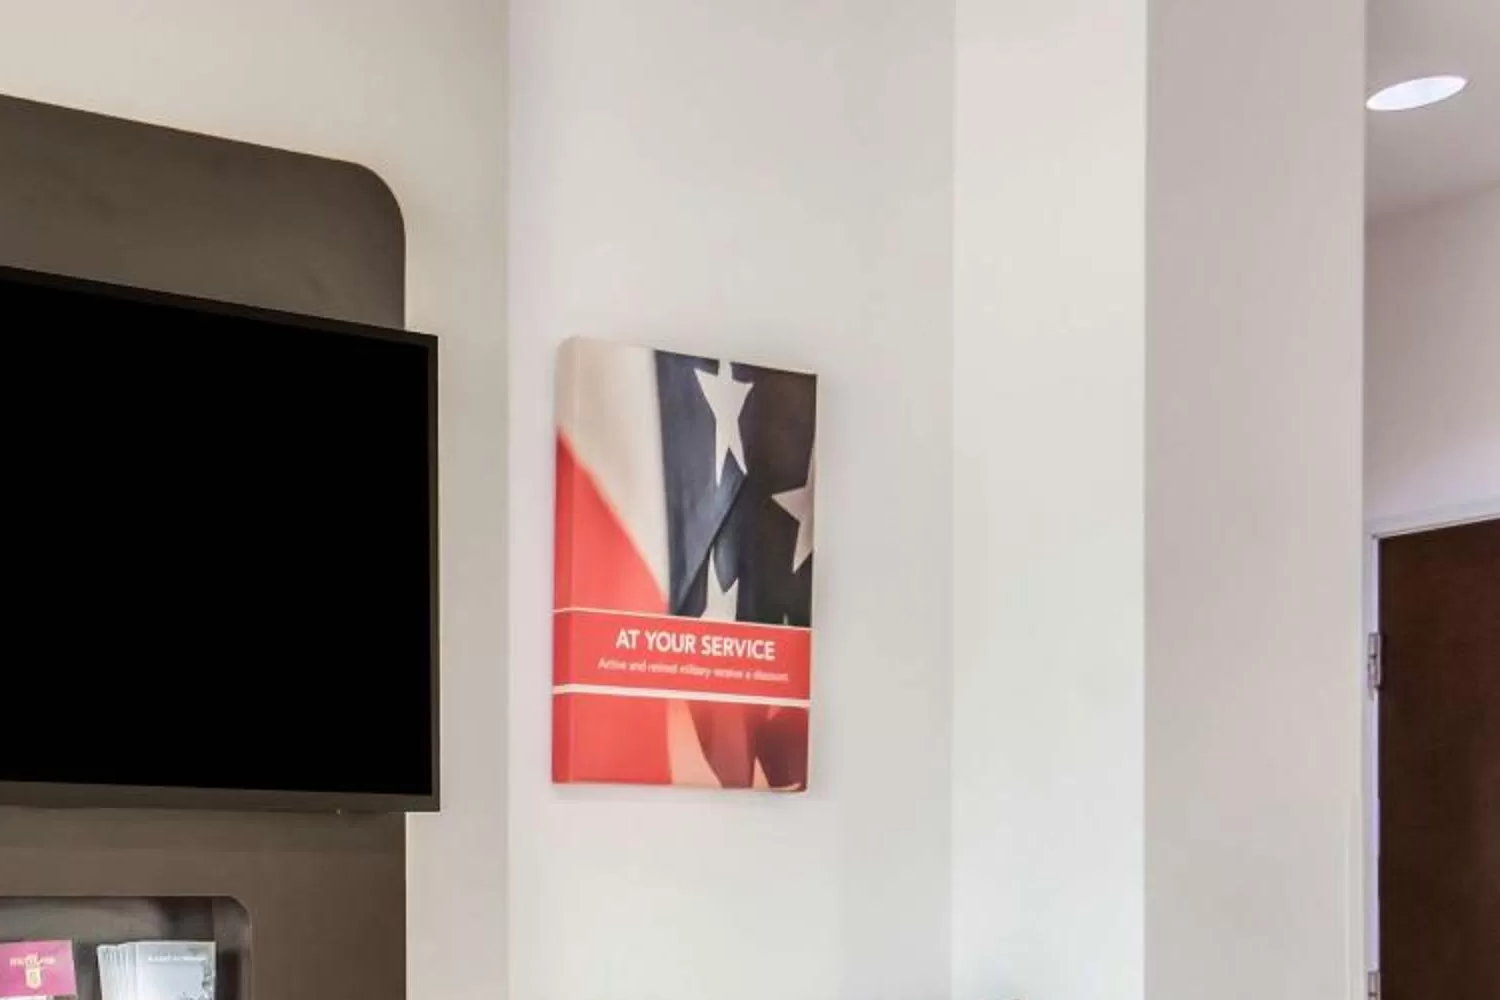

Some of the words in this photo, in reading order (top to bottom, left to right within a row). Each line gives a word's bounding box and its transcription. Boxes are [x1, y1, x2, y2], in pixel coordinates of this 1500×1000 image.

[615, 628, 640, 649] AT
[644, 629, 696, 655] YOUR
[701, 635, 776, 661] SERVICE
